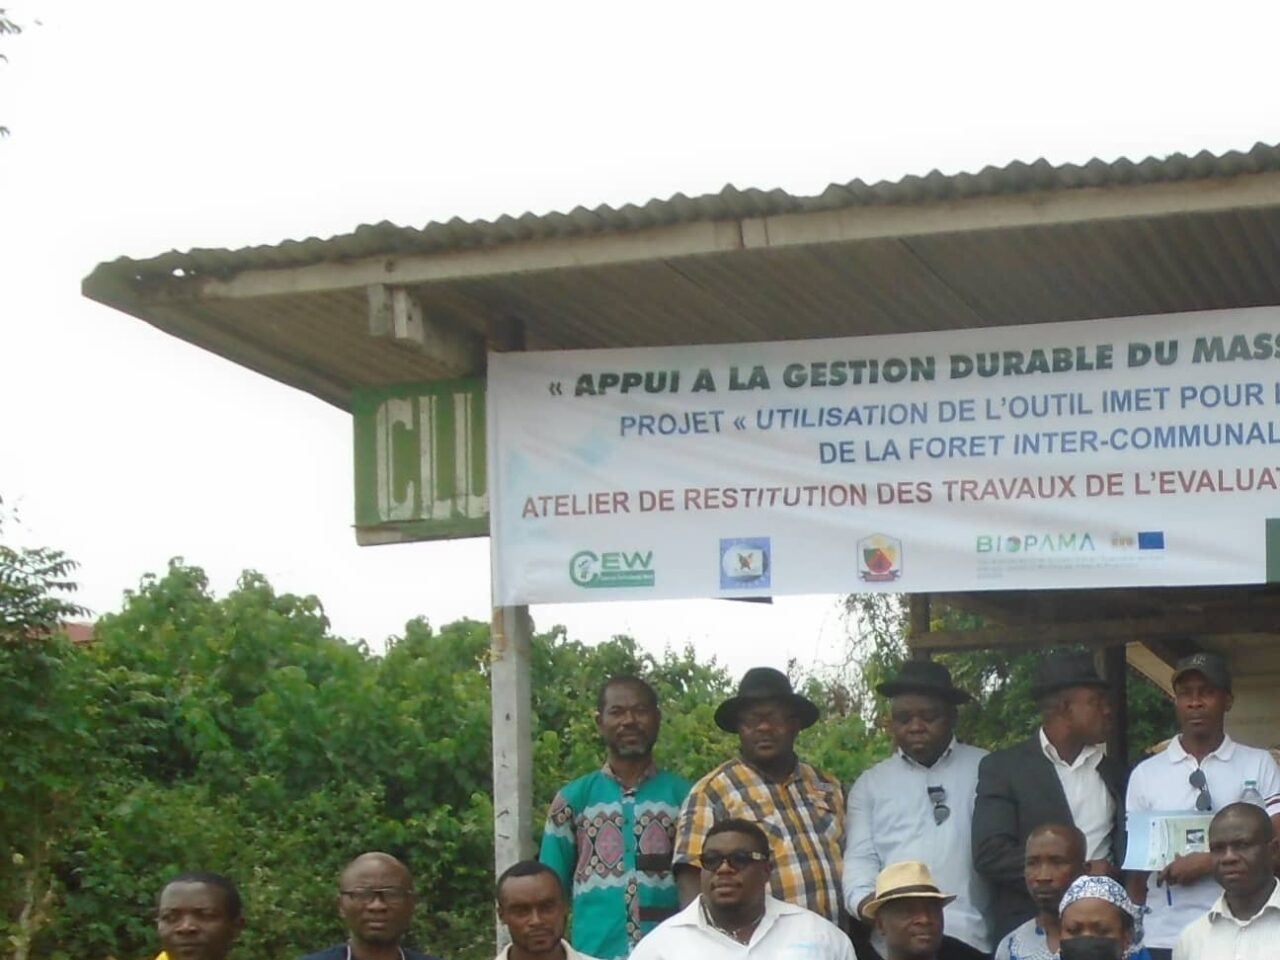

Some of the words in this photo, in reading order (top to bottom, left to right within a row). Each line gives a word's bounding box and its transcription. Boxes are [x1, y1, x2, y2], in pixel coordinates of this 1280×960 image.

[574, 370, 680, 397] APPUI
[691, 368, 716, 393] A
[728, 364, 771, 392] LA
[783, 355, 935, 390] GESTION
[950, 344, 1113, 379] DURABLE
[1127, 339, 1178, 369] DU
[620, 410, 724, 437] PROJET
[757, 402, 927, 431] UTILISATION
[938, 398, 975, 423] DE
[986, 392, 1093, 421] L’OUTIL
[1102, 387, 1170, 414] IMET
[1180, 382, 1264, 410] POUR
[819, 440, 856, 464] DE
[865, 438, 901, 463] LA
[909, 435, 1005, 461] FORET
[522, 491, 630, 519] ATELIER
[639, 489, 675, 512] DE
[684, 483, 867, 510] RESTITUTION
[876, 481, 933, 505] DES
[942, 475, 1076, 502] TRAVAUX
[1086, 473, 1124, 497] DE
[976, 532, 1095, 553] BIOPAMA
